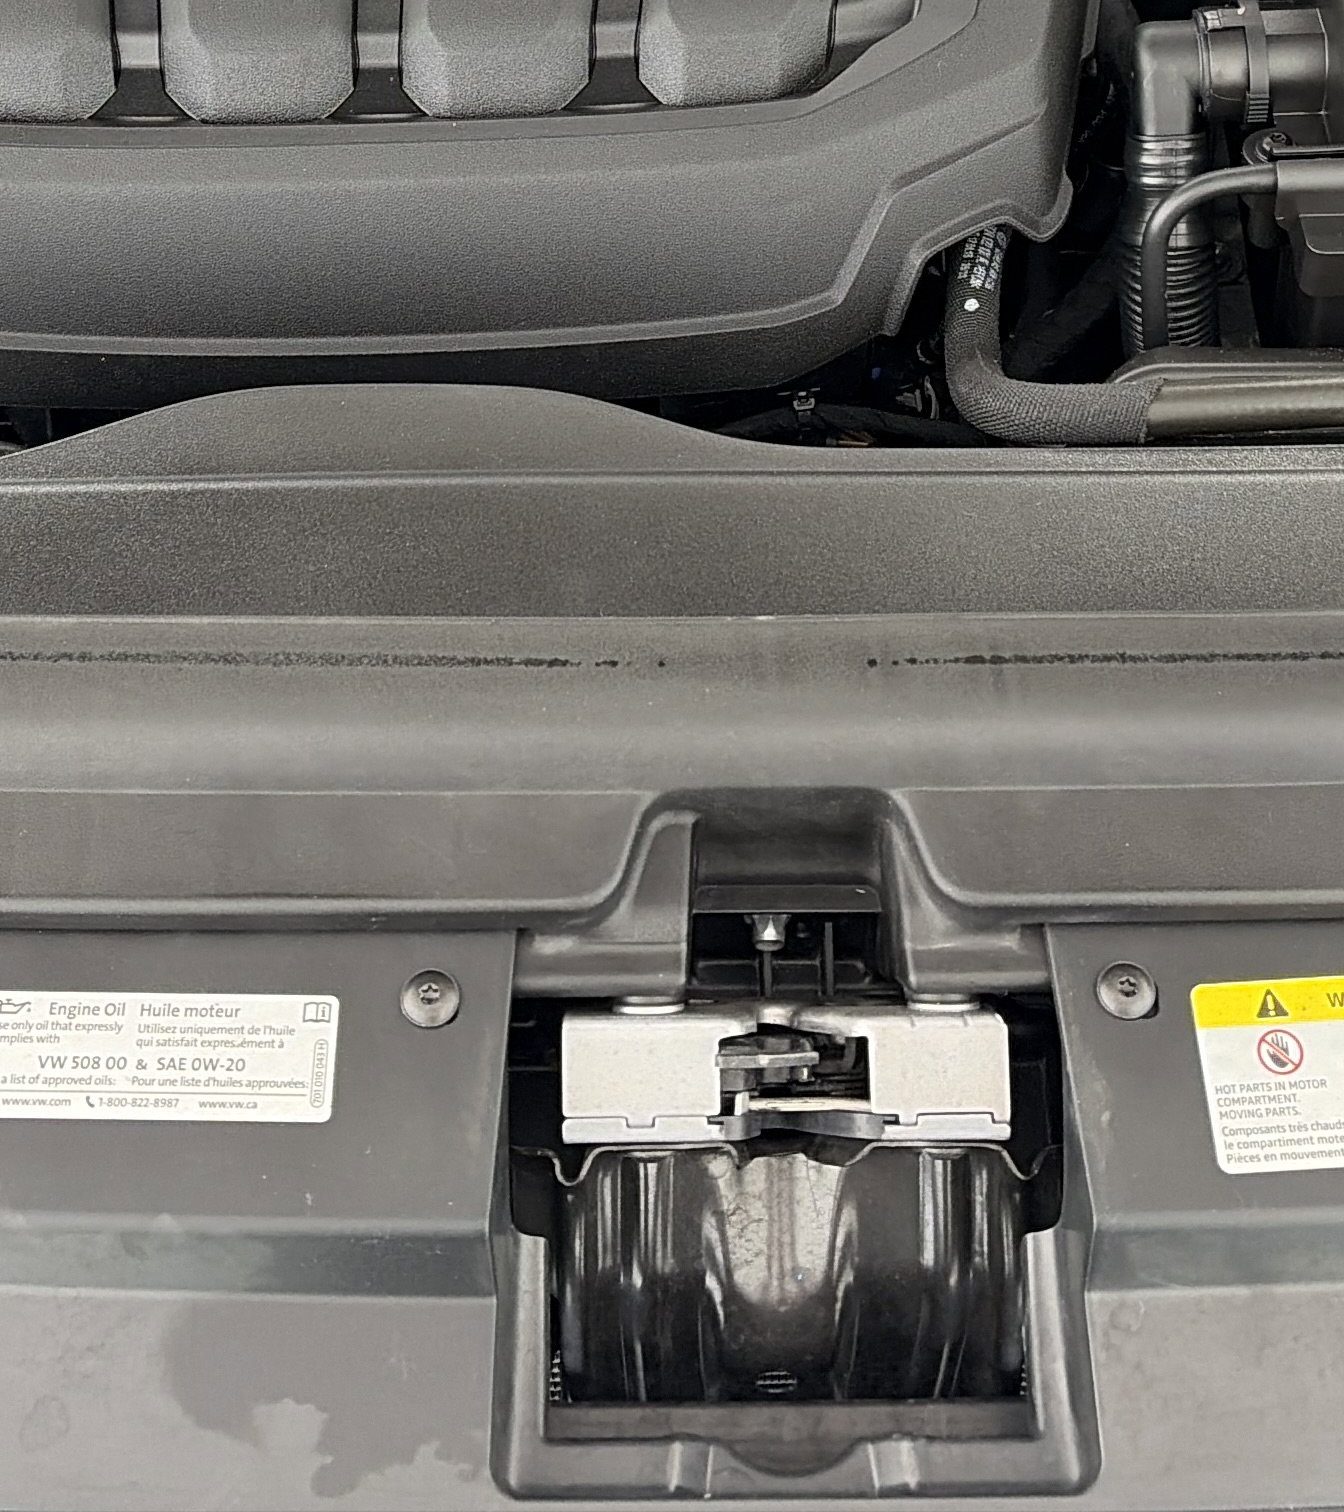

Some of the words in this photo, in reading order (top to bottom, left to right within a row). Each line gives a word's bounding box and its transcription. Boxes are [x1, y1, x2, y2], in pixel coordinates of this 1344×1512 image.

[48, 1002, 101, 1019] Engine
[104, 1002, 126, 1017] Oil
[140, 1003, 180, 1018] Huile
[184, 1003, 241, 1018] moteur
[11, 1020, 34, 1033] only
[36, 1020, 49, 1031] oil
[51, 1020, 72, 1031] that
[74, 1022, 123, 1035] expressly
[137, 1024, 177, 1035] Utilisez
[179, 1024, 245, 1037] uniquement
[247, 1025, 261, 1036] de
[262, 1025, 296, 1036] l'huile
[36, 1034, 60, 1044] with
[136, 1037, 154, 1049] qui
[156, 1037, 198, 1048] satisfait
[278, 1039, 285, 1048] à
[317, 1042, 326, 1050] H
[38, 1055, 68, 1069] VW
[71, 1056, 101, 1070] 508
[105, 1056, 127, 1070] 00
[135, 1058, 148, 1070] &
[156, 1057, 187, 1071] SAE
[191, 1058, 246, 1072] 0W-20
[0, 1076, 7, 1085] a
[10, 1074, 26, 1085] list
[27, 1074, 41, 1085] of
[41, 1074, 92, 1087] approved
[94, 1075, 116, 1086] oils:
[131, 1076, 157, 1086] Pour
[158, 1078, 178, 1087] une
[180, 1077, 202, 1088] liste
[203, 1078, 244, 1089] d'huiles
[245, 1078, 309, 1092] approuvées:
[314, 1070, 324, 1086] 010
[1214, 1084, 1236, 1095] HOT
[1239, 1081, 1272, 1094] PARTS
[1274, 1081, 1286, 1092] IN
[1289, 1078, 1328, 1091] MOTOR
[2, 1097, 71, 1106] www.vw.com
[98, 1096, 179, 1109] 1-800-822-8987
[198, 1099, 258, 1109] www.vw.ca
[1217, 1093, 1301, 1108] COMPARTMENT.
[1219, 1108, 1264, 1120] MOVING
[1265, 1106, 1302, 1117] PARTS.
[1221, 1123, 1287, 1139] Composants
[1288, 1121, 1309, 1133] très
[1224, 1139, 1234, 1150] le
[1237, 1135, 1314, 1152] compartiment
[1226, 1152, 1261, 1164] Pièces
[1264, 1154, 1277, 1162] en
